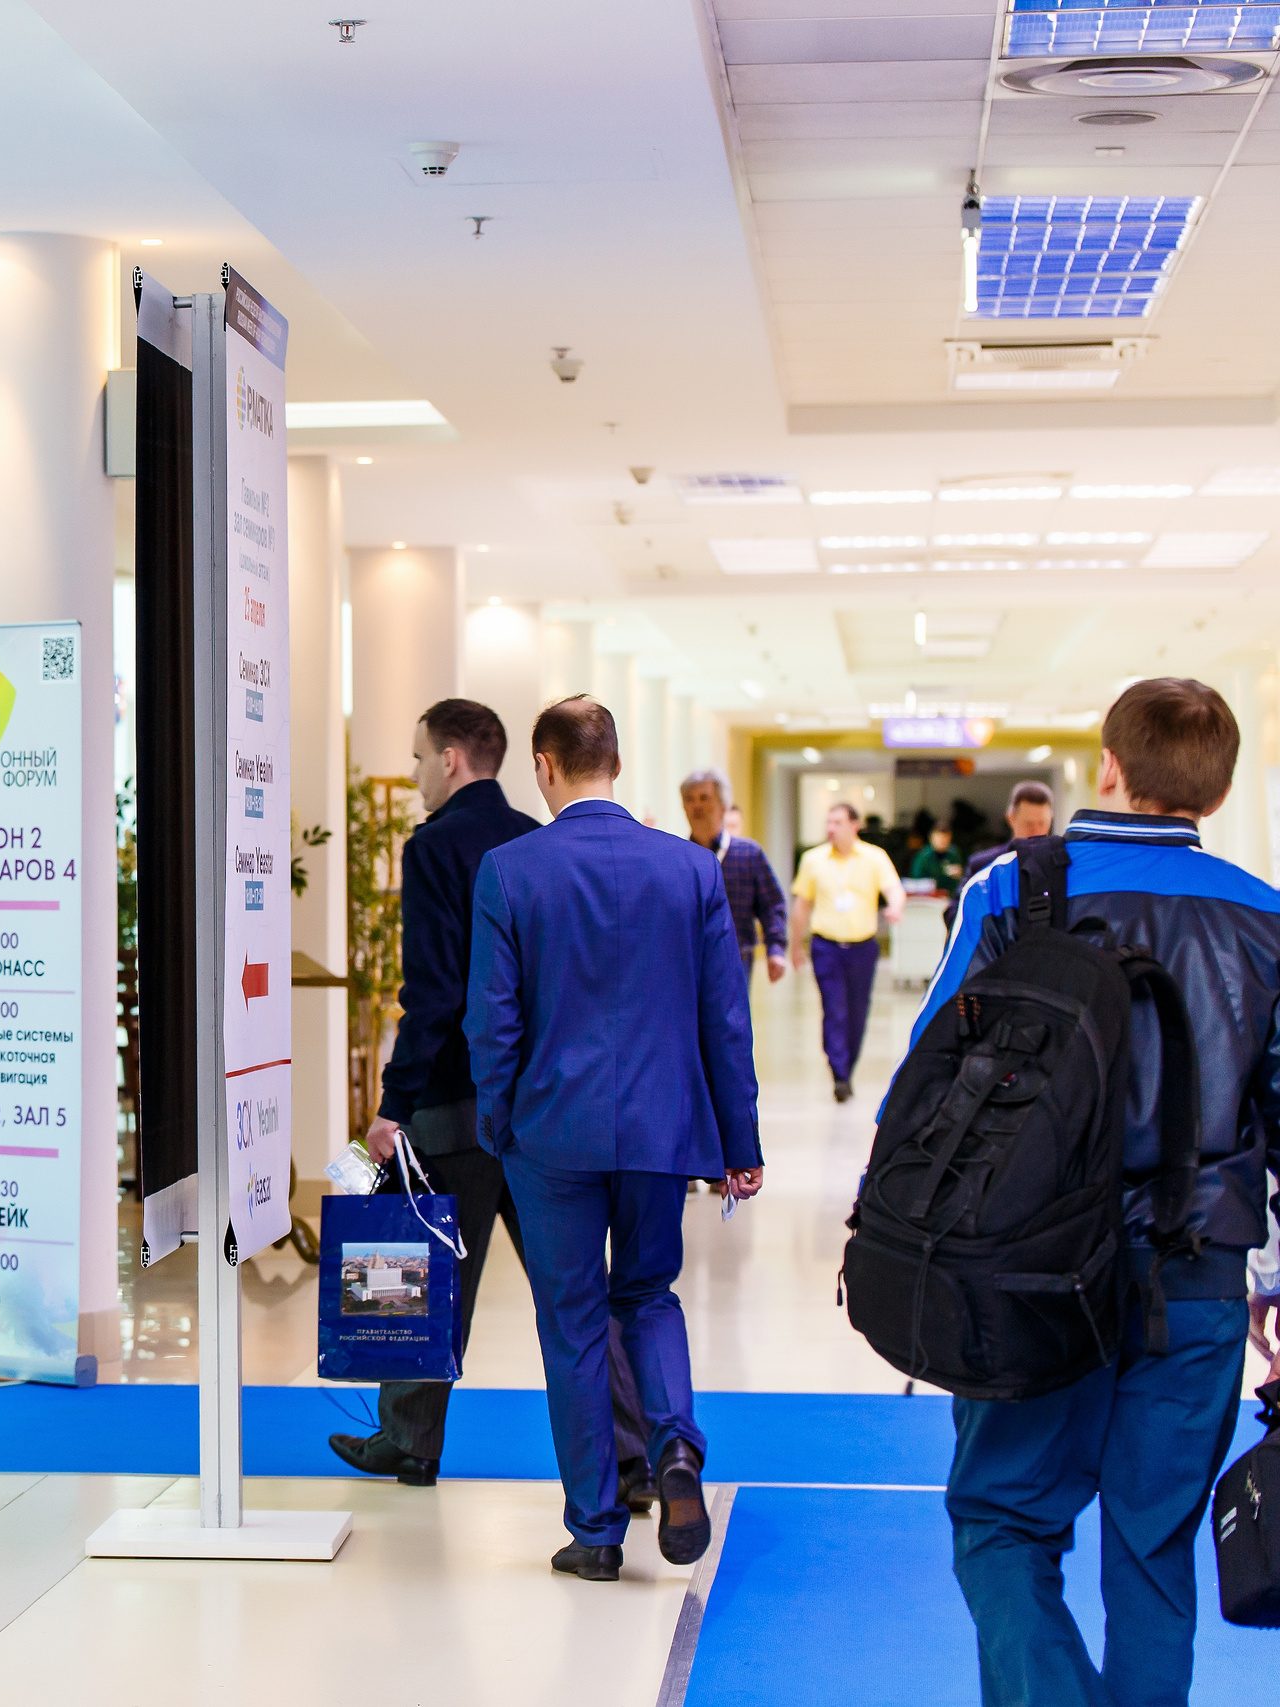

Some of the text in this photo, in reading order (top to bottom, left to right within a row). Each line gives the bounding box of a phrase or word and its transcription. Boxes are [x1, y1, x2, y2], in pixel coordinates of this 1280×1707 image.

[3, 770, 57, 787] ФОРУМ
[31, 827, 42, 848] 2
[63, 859, 77, 880] 4
[16, 1030, 73, 1043] системы
[14, 1106, 49, 1126] ЗАЛ
[56, 1108, 67, 1127] 5
